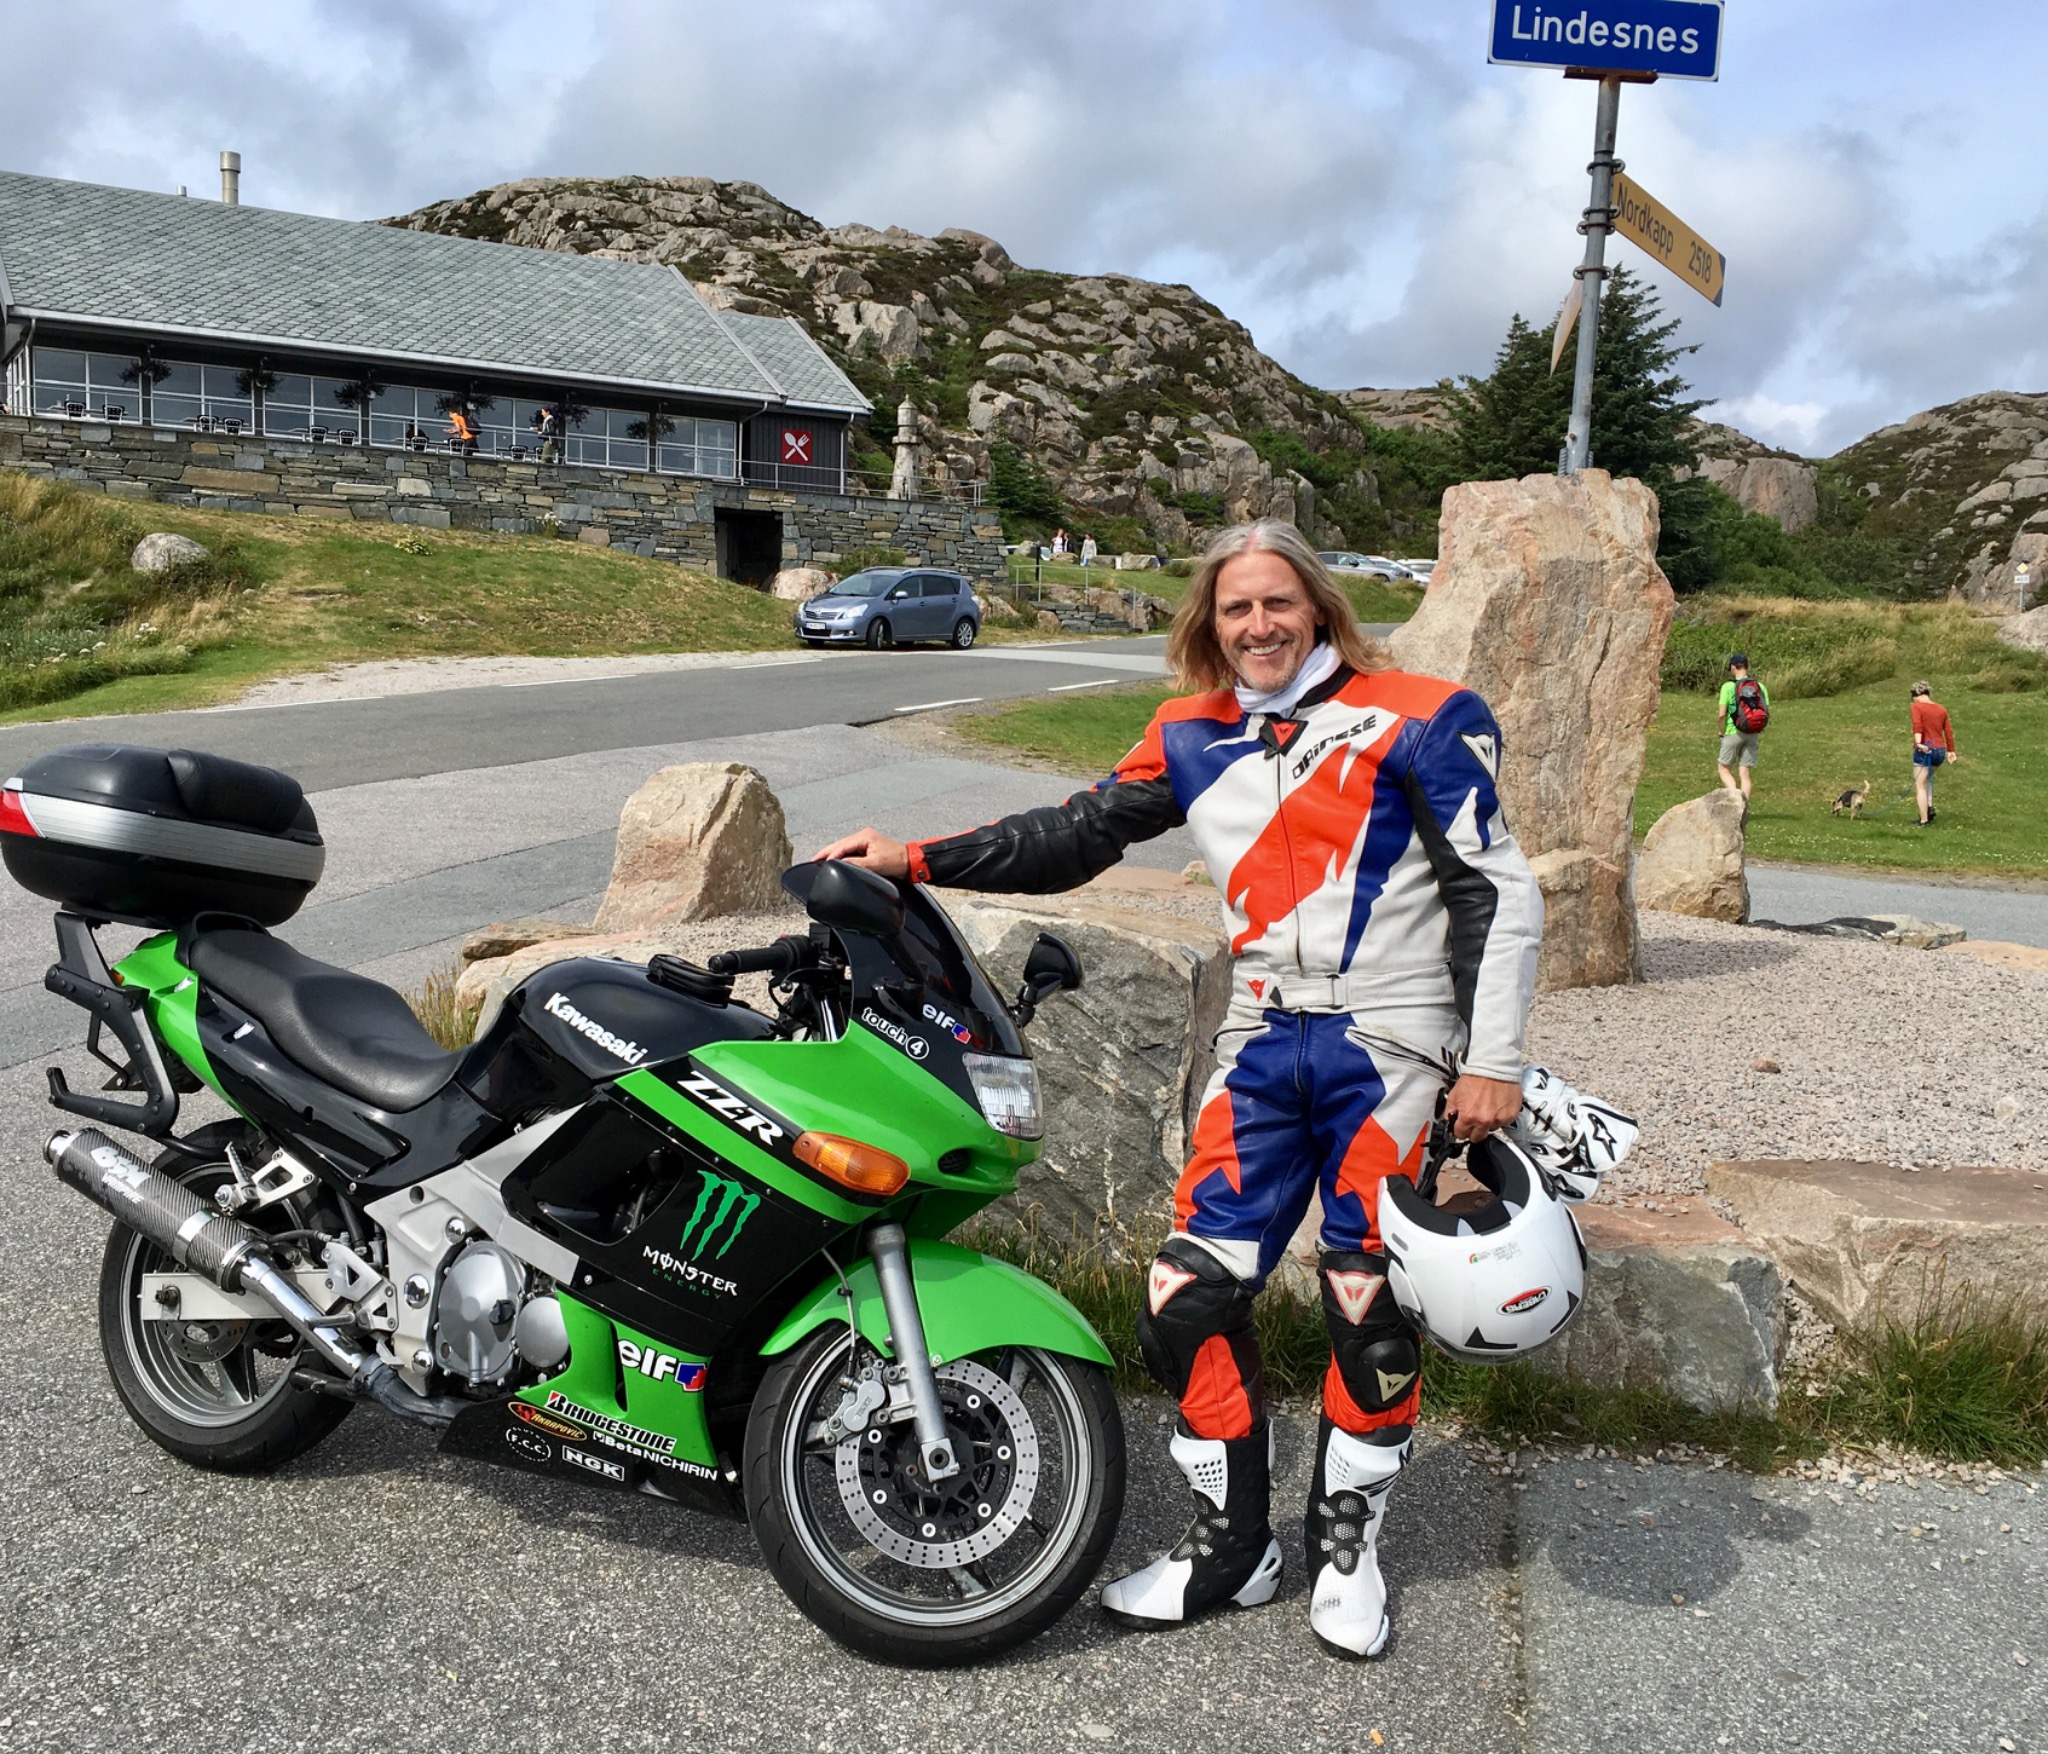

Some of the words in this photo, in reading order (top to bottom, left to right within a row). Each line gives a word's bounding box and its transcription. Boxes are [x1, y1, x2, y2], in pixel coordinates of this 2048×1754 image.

[1511, 4, 1700, 55] Lindesnes
[1616, 181, 1675, 260] Nordkapp
[1686, 239, 1713, 285] 2518
[543, 991, 648, 1066] Kawasaki
[861, 1006, 908, 1046] touch
[908, 1039, 926, 1058] 4
[922, 1003, 956, 1030] elf
[642, 1245, 738, 1297] MONSTER
[652, 1267, 722, 1300] ENERGY
[618, 1339, 677, 1381] elf
[546, 1390, 677, 1454] BRIDGESTONE
[511, 1434, 547, 1456] F.C.C.
[565, 1447, 623, 1479] NGK
[603, 1436, 642, 1457] Beta
[643, 1450, 719, 1482] NICHIRIN
